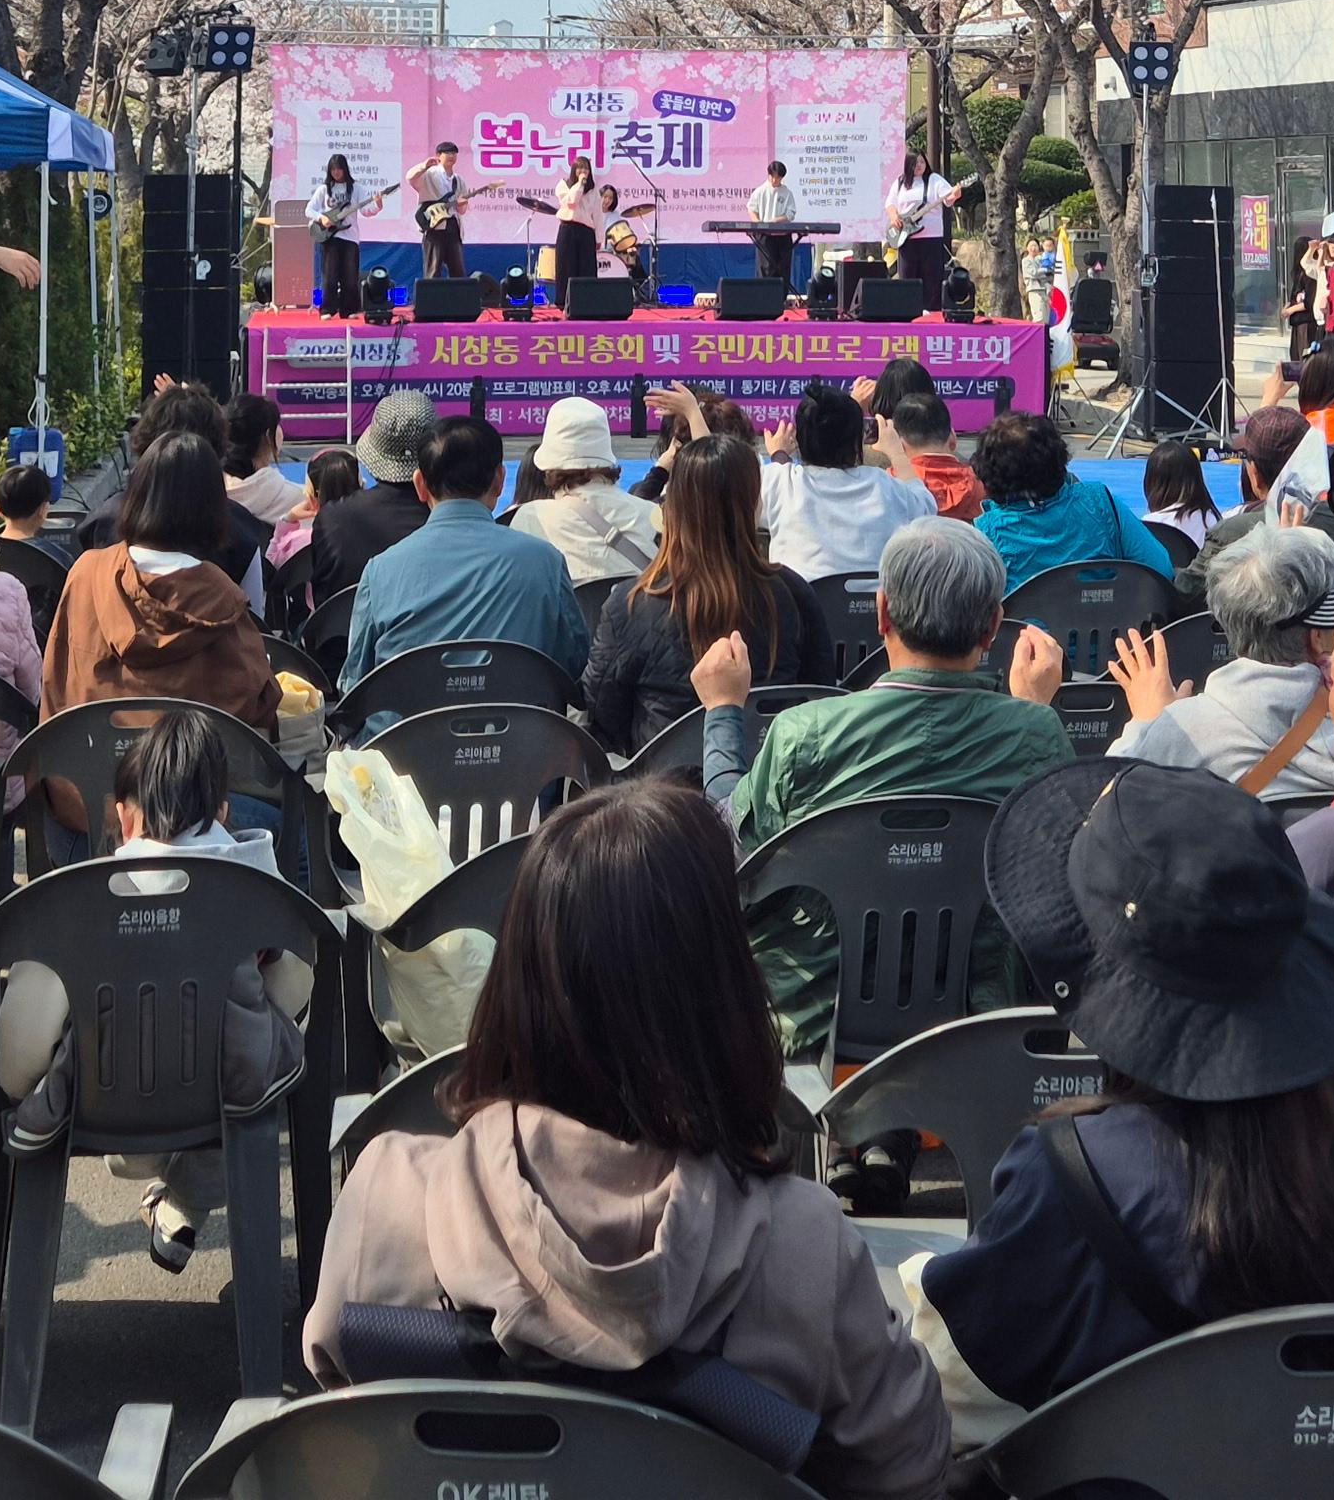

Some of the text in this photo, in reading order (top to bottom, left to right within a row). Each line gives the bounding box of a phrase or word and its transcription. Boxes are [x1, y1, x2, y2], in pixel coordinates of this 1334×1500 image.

[563, 92, 625, 113] 서창동
[660, 93, 724, 117] 꽃들의 향연
[430, 336, 520, 367] 서창동
[529, 334, 644, 365] 주민총회
[652, 334, 681, 365] 및
[690, 334, 920, 364] 주민자치프로그램
[925, 336, 1011, 365] 발표회
[361, 384, 386, 398] 오후
[423, 383, 443, 398] 4시
[492, 380, 576, 397] 프로그램발표회
[587, 380, 611, 395] 오후
[741, 379, 778, 395] 통기타
